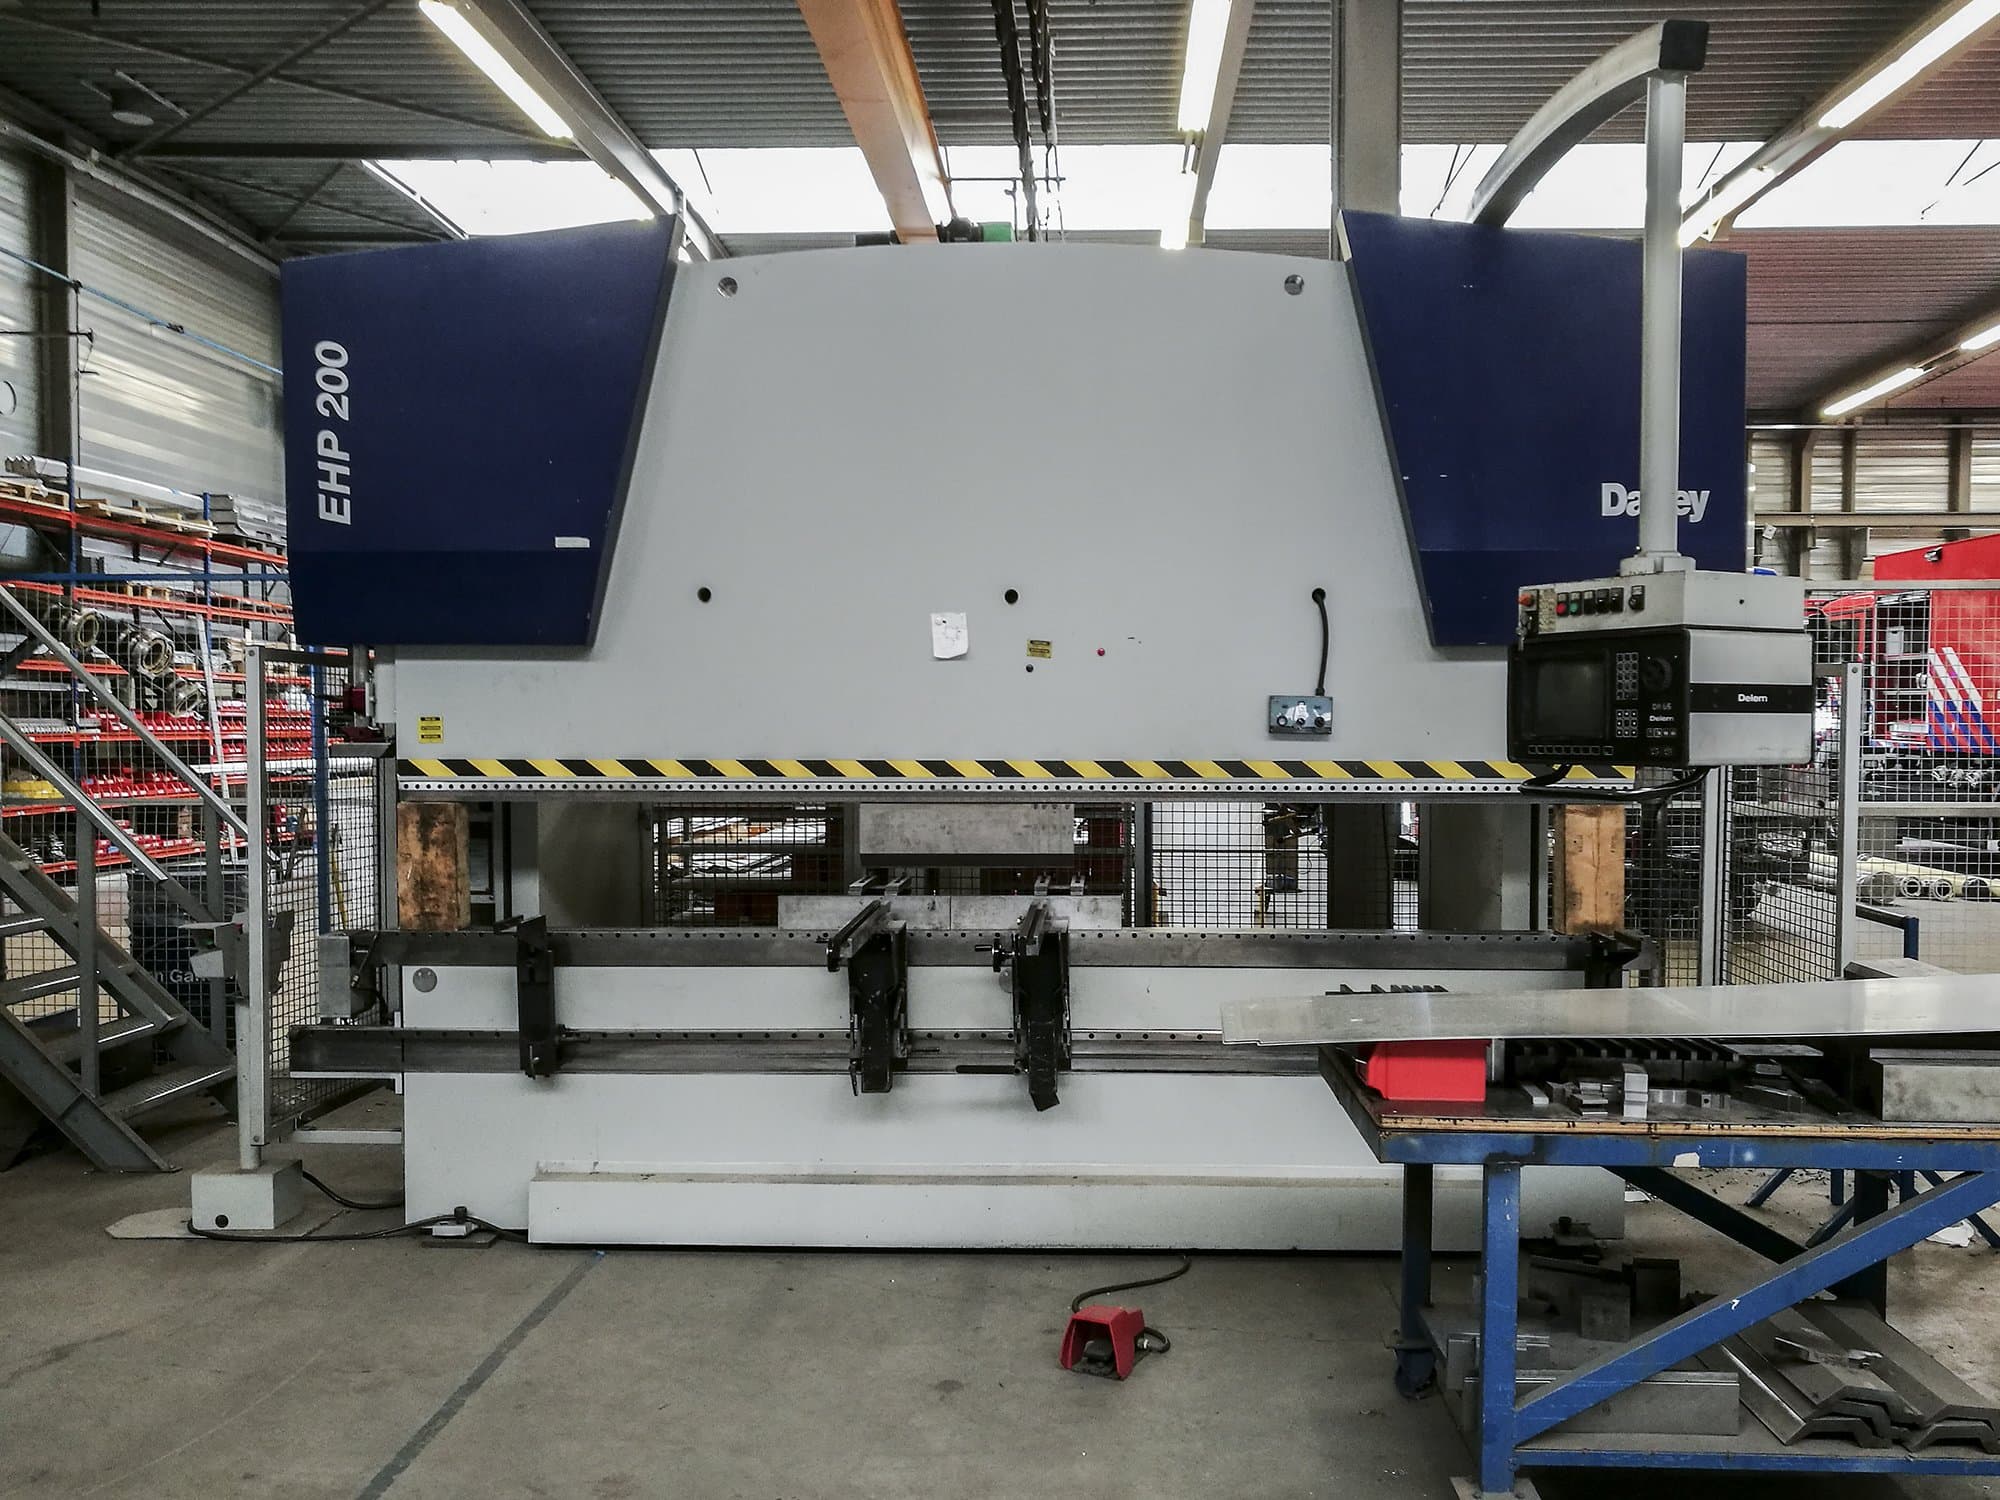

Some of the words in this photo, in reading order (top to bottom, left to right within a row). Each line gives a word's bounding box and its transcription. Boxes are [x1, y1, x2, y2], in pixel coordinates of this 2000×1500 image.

[315, 340, 349, 421] 200
[317, 429, 351, 525] EHP
[1602, 482, 1710, 523] Daey
[1738, 693, 1768, 702] Delem
